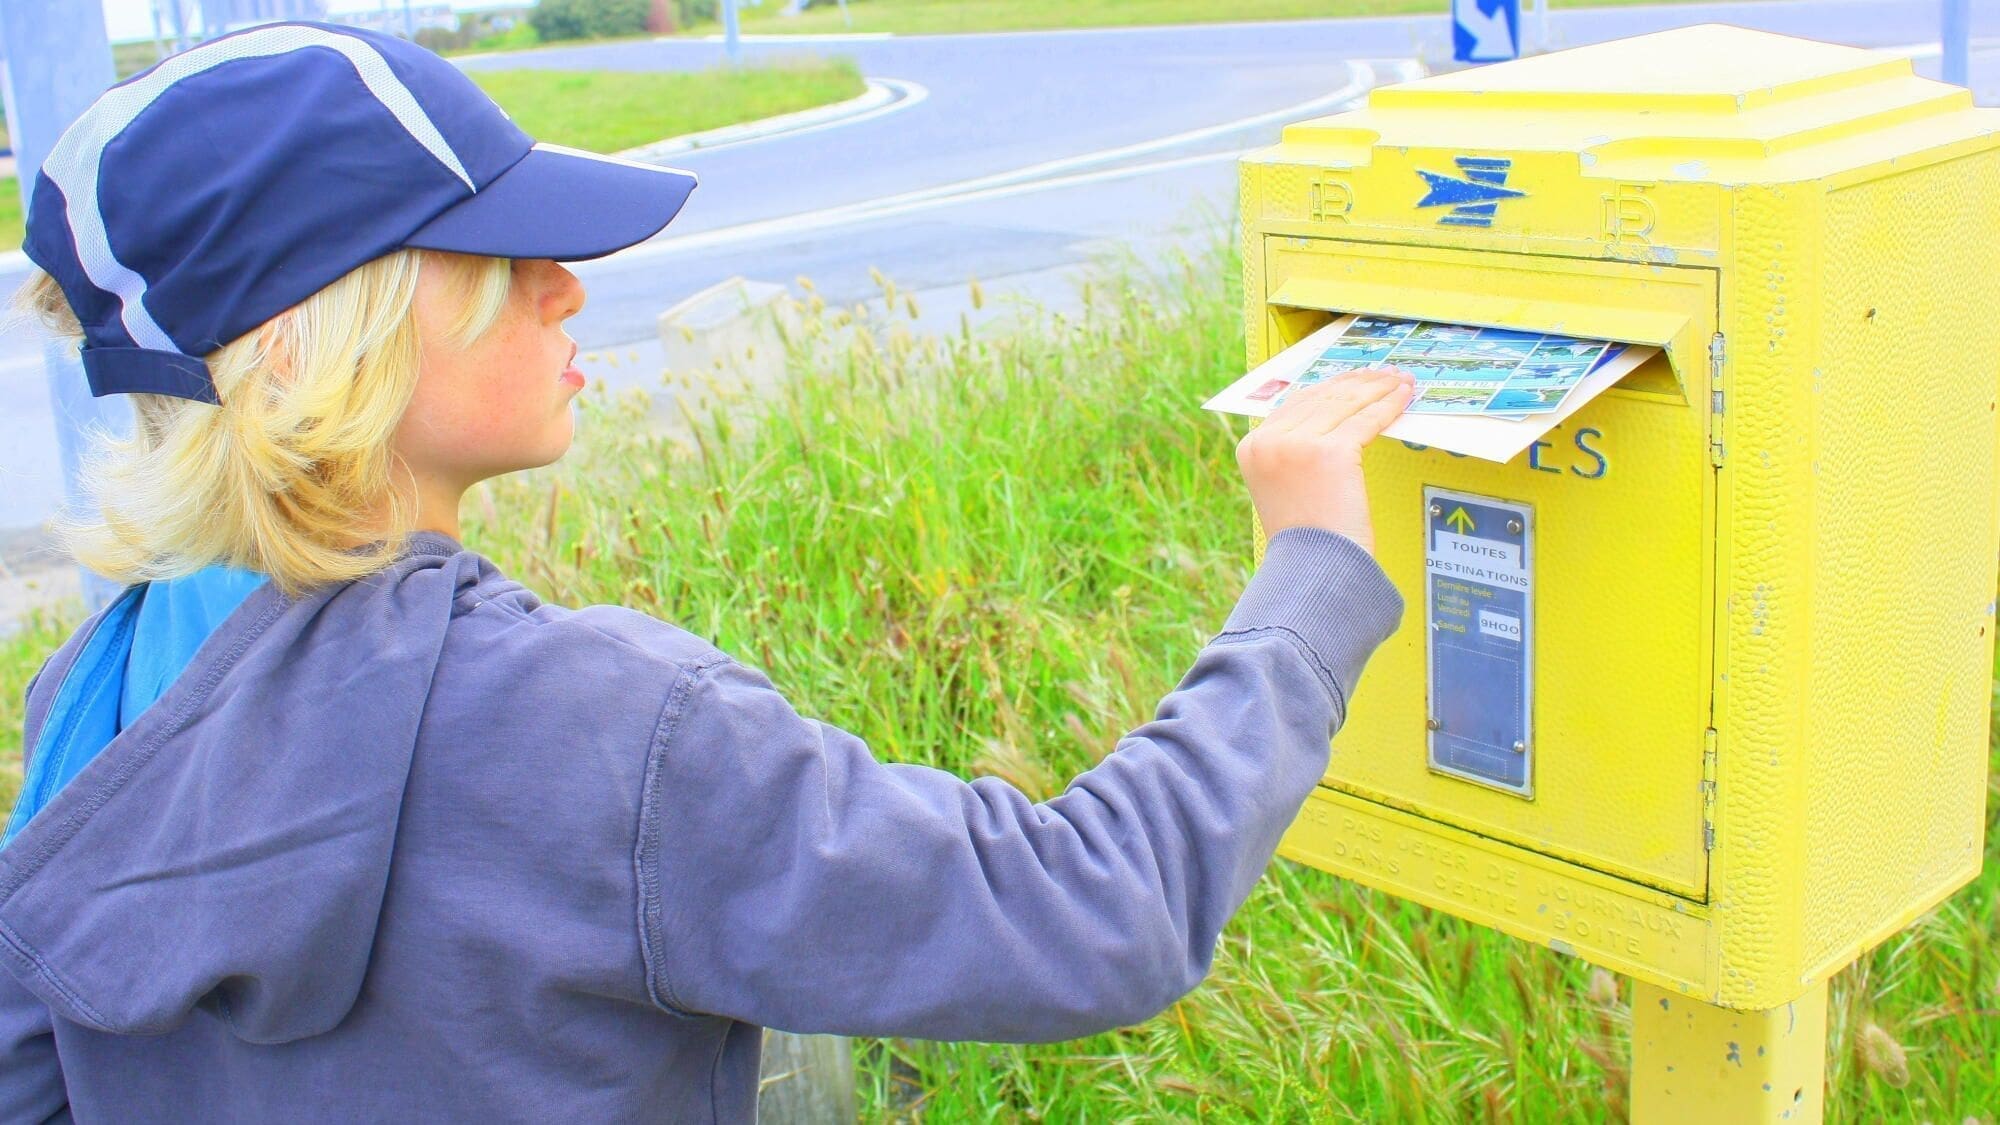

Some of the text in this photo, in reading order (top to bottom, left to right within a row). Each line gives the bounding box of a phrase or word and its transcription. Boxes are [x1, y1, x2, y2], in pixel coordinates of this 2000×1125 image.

[1451, 541, 1507, 560] TOUTES
[1426, 558, 1528, 587] DESTINATIONS
[1438, 619, 1466, 633] Samedi
[1342, 816, 1383, 842] PAS
[1397, 836, 1470, 872] JETER
[1487, 863, 1520, 889] DE
[1536, 882, 1683, 941] JOURNAUX
[1334, 839, 1641, 956] DANS CETTE BOITE
